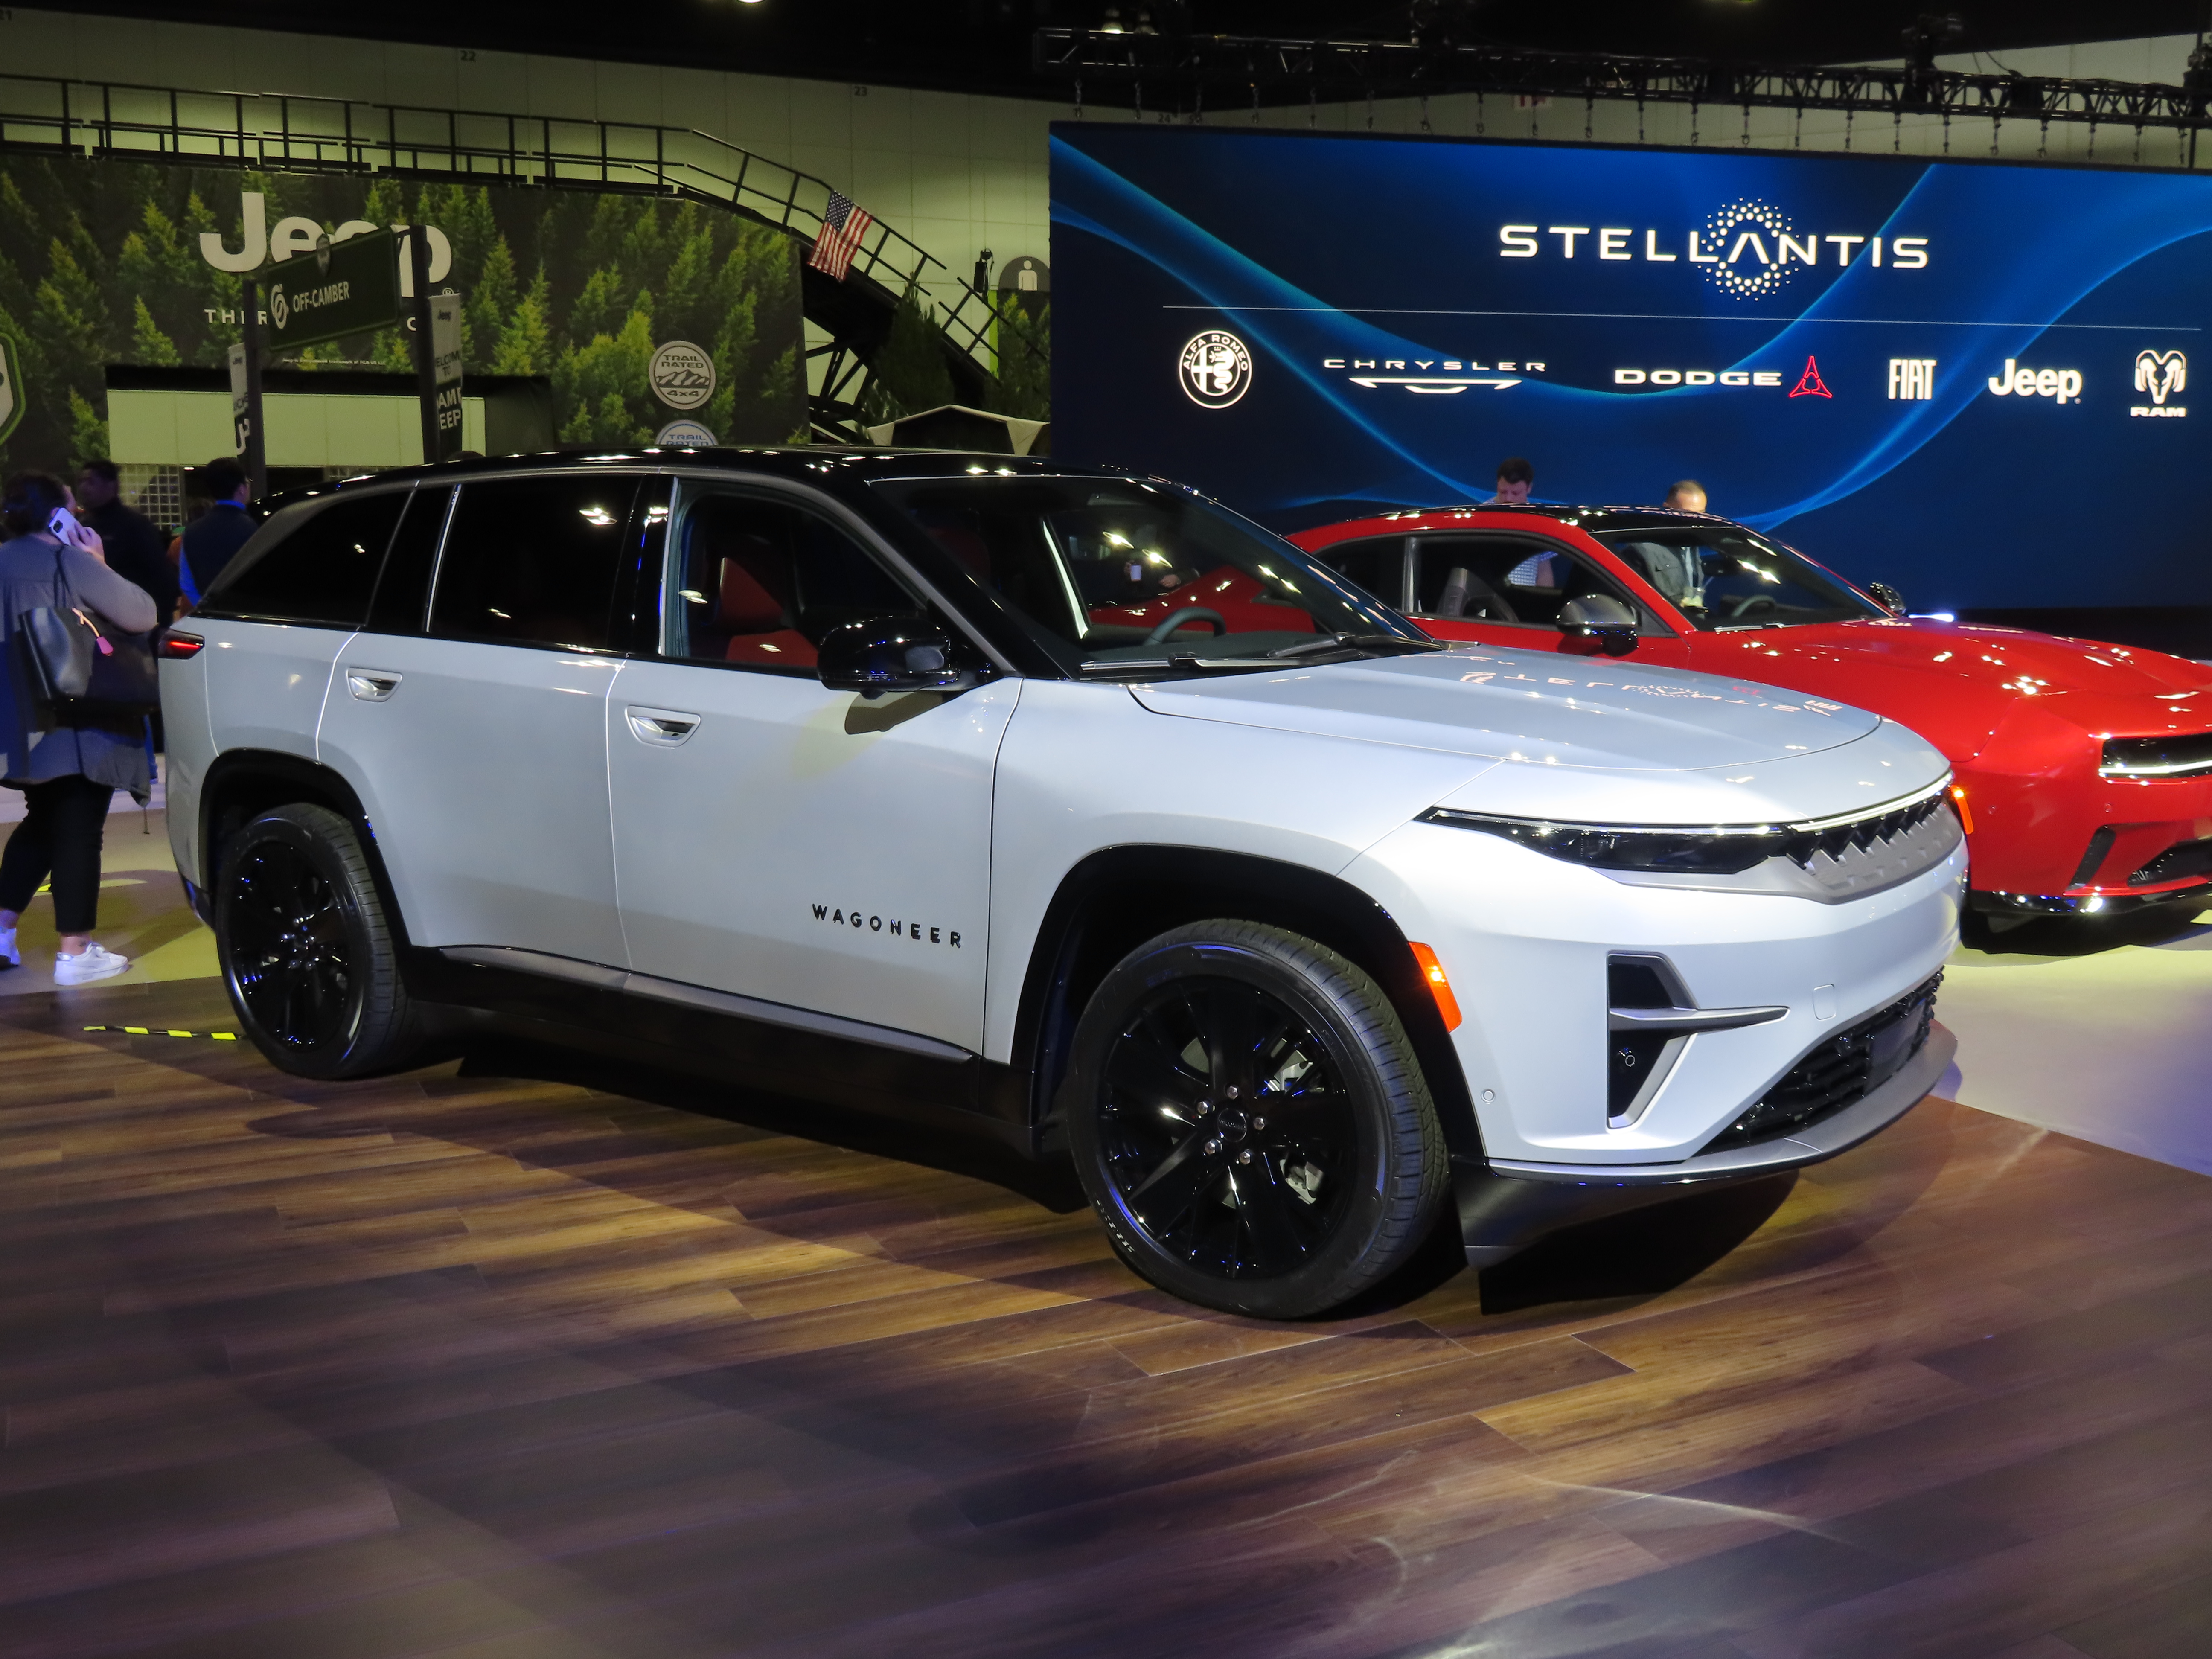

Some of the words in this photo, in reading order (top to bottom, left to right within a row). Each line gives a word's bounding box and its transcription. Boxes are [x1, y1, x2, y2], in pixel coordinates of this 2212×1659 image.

[461, 50, 476, 62] 22
[855, 86, 867, 96] 23
[1500, 226, 1927, 269] STELLANTIS
[293, 281, 350, 312] OFF-CAMBER
[1183, 338, 1206, 370] ALFA
[1212, 335, 1248, 371] ROMEO
[1324, 359, 1545, 371] CHRYSLER
[1615, 370, 1781, 386] DODGE
[1889, 359, 1936, 399] FIAT
[1989, 358, 2083, 404] Jeep
[439, 408, 461, 430] EEP
[2130, 407, 2186, 417] RAM
[812, 904, 961, 949] WAGONEER
